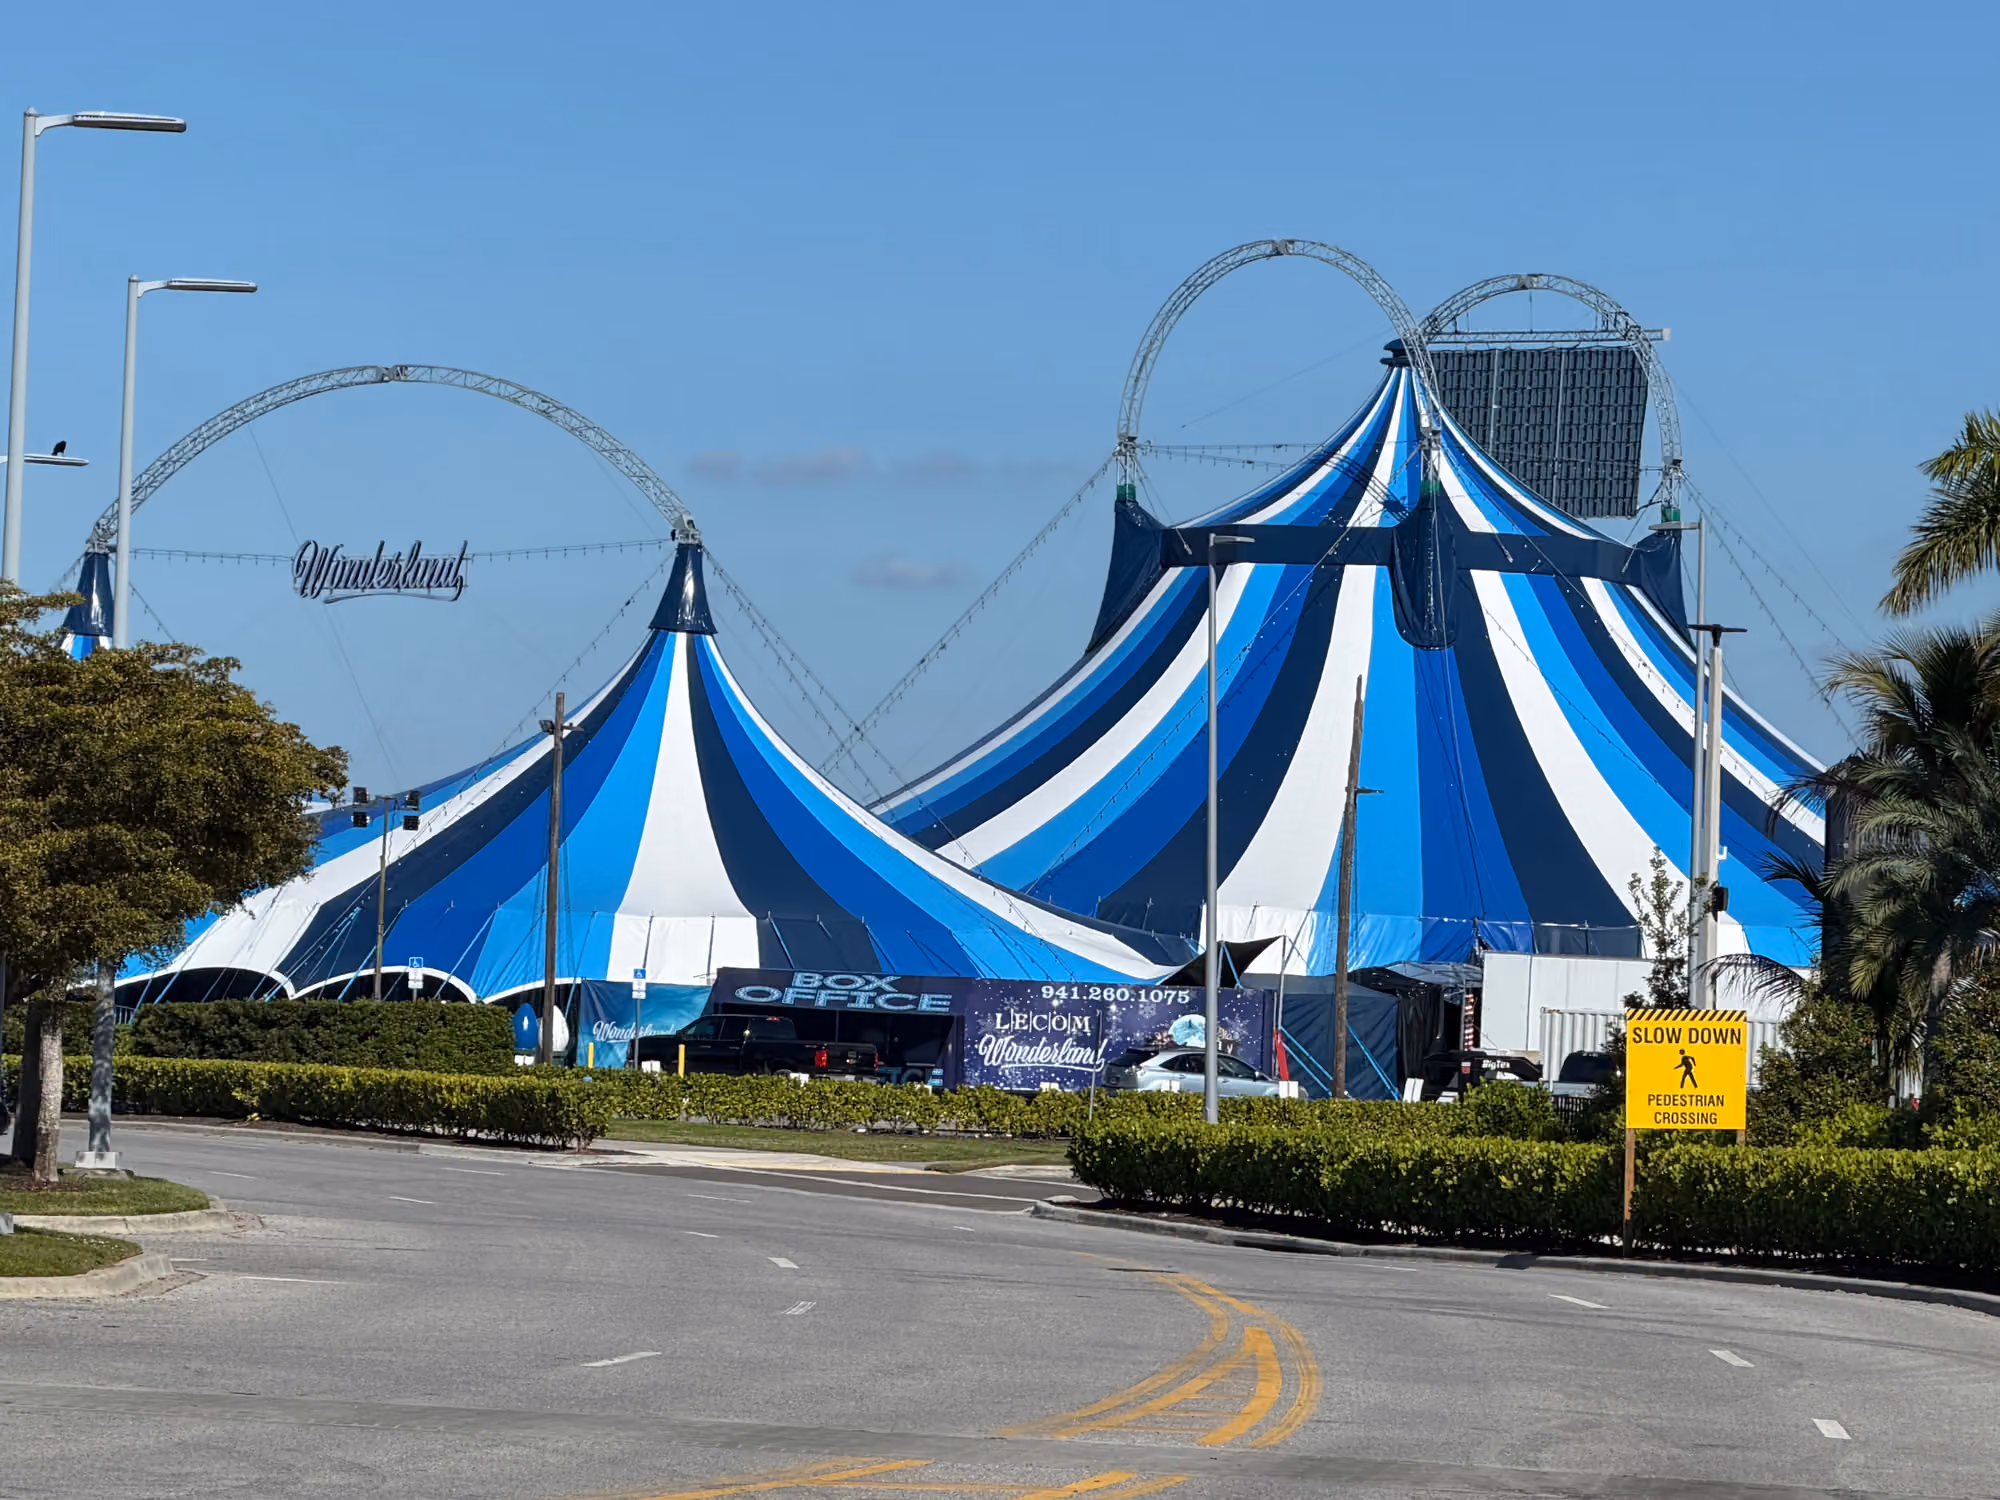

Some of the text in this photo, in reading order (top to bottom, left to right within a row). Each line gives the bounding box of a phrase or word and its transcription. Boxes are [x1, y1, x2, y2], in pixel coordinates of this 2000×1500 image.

[292, 540, 468, 605] Wonderland
[792, 971, 901, 993] BOX
[734, 985, 952, 1012] OFFICE
[1041, 985, 1190, 1004] 941.260.1075
[1632, 1027, 1741, 1045] SLOW DOWN
[978, 1033, 1108, 1073] Wonderland
[1647, 1094, 1725, 1107] PEDESTRIAN
[1654, 1112, 1718, 1125] CROSSING
